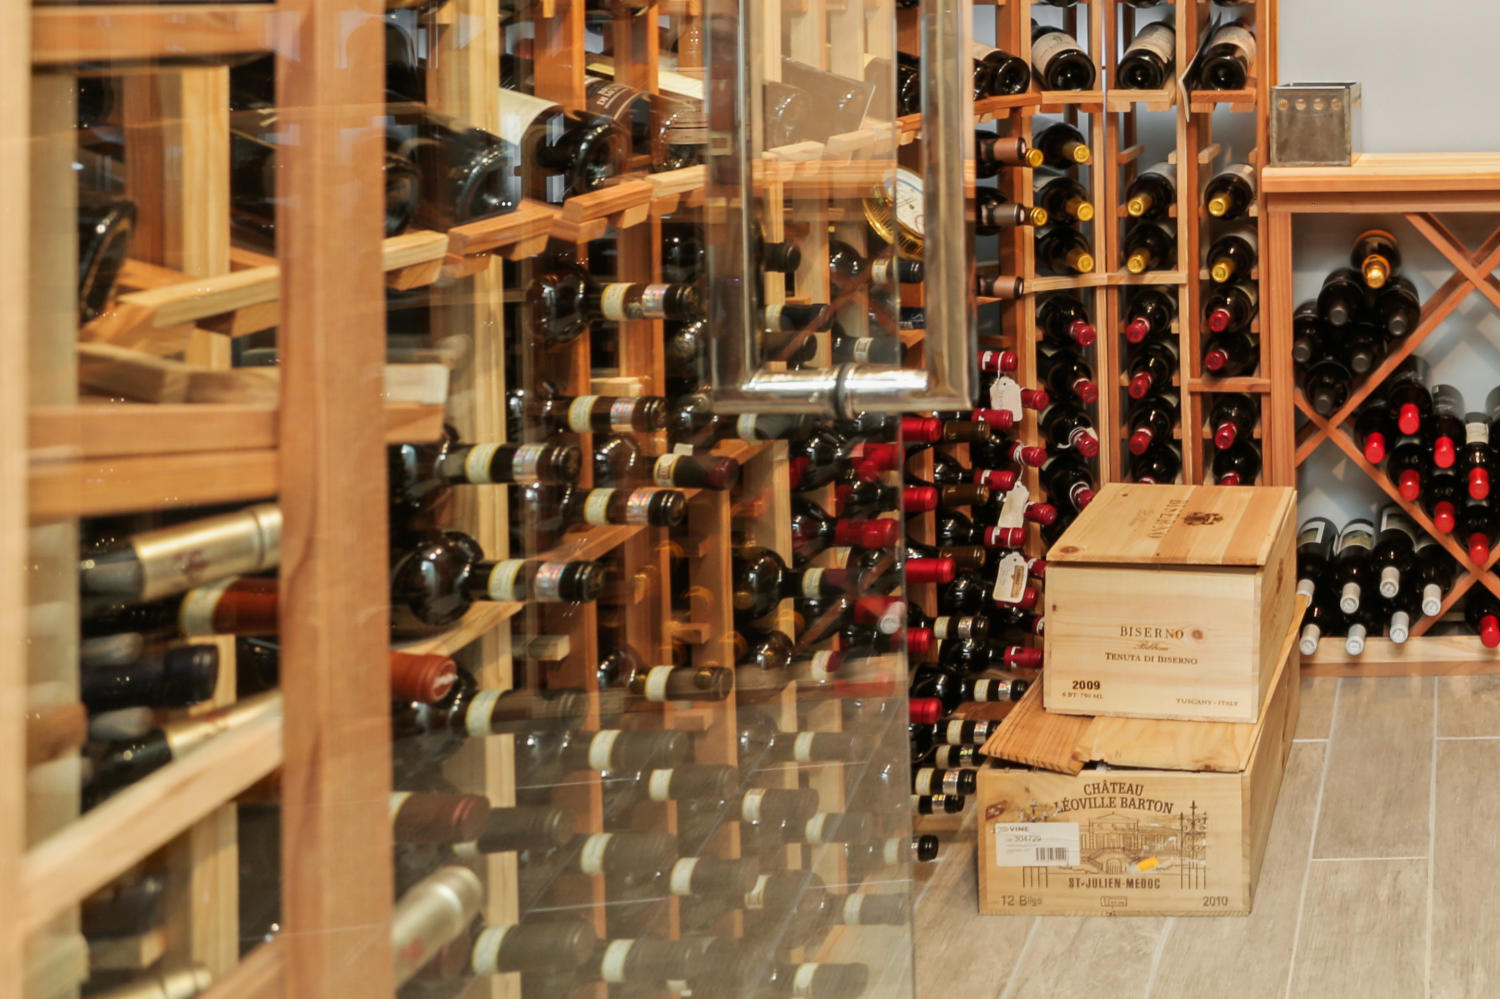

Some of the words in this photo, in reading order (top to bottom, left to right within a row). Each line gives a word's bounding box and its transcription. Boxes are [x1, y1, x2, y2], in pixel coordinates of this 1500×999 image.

[1120, 625, 1185, 640] BISERNO
[1105, 652, 1141, 662] TENUTA
[1143, 655, 1155, 663] DI
[1157, 655, 1198, 665] BISERNO
[1072, 680, 1101, 690] 2009
[1083, 780, 1144, 796] CHÂTEAU
[1054, 797, 1117, 814] LÉOVILLE
[1120, 797, 1174, 814] BARTON
[1001, 896, 1015, 906] 12
[1203, 896, 1228, 907] 2010
